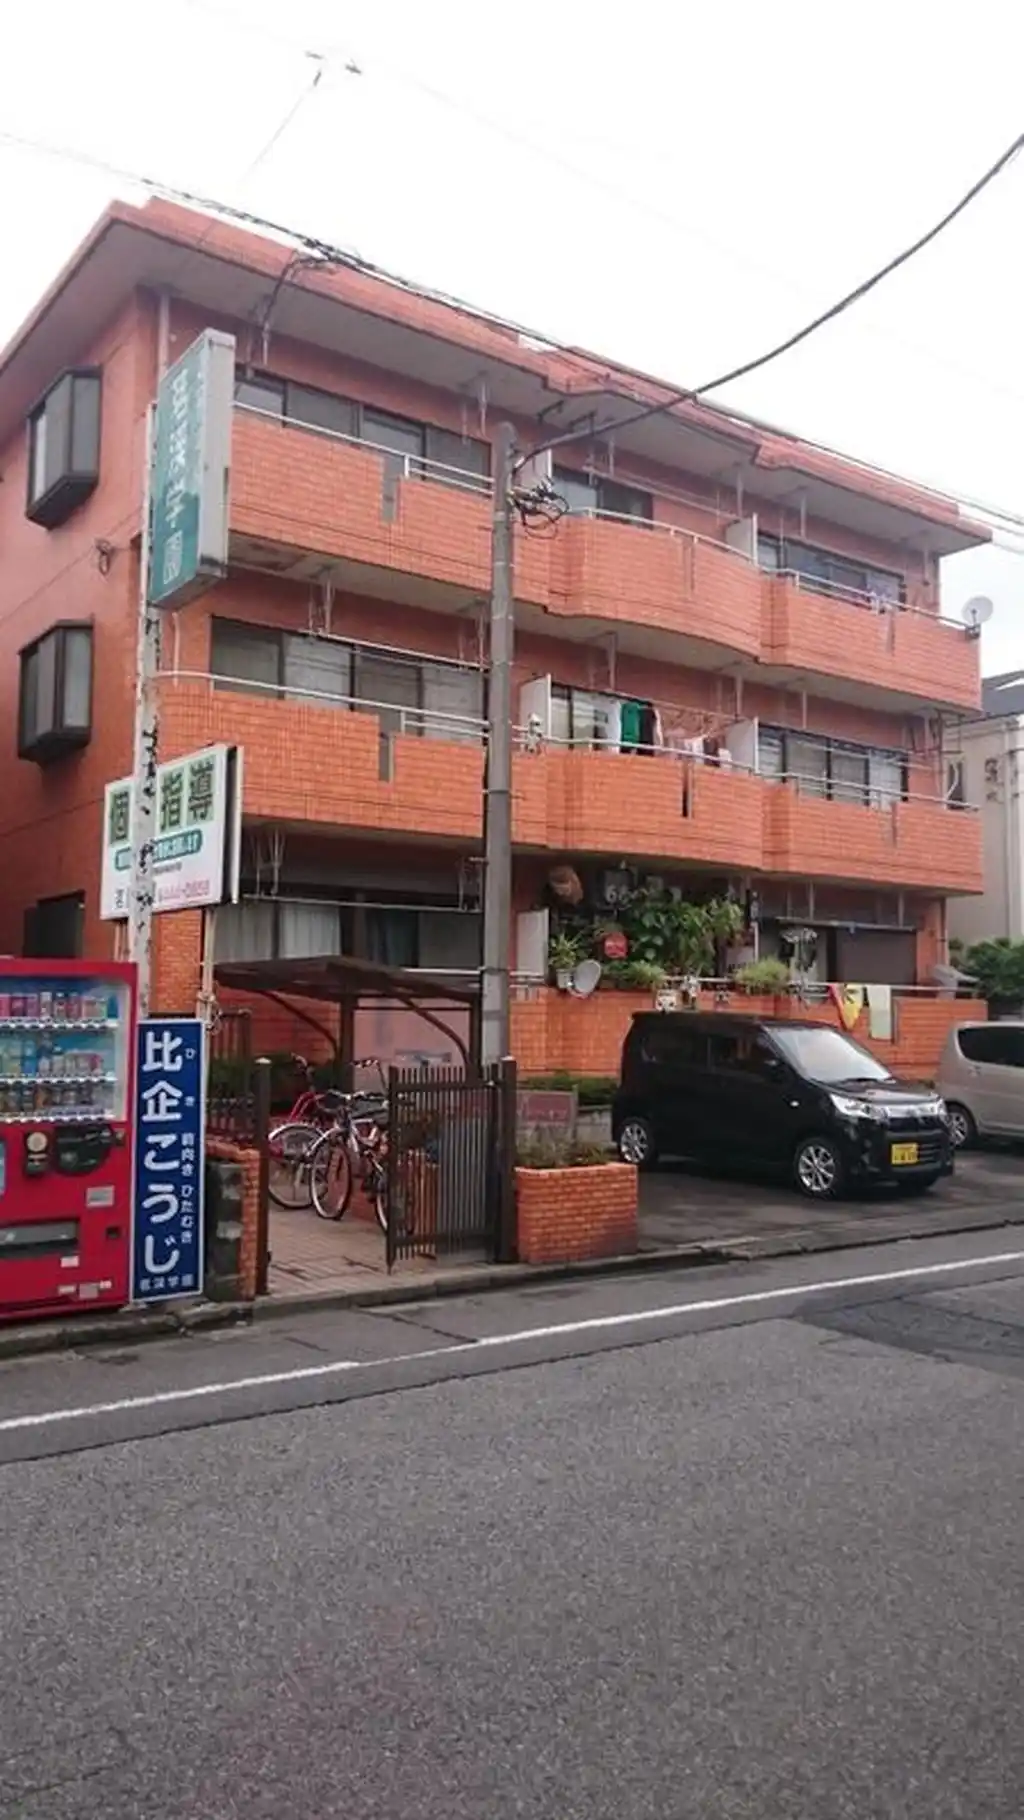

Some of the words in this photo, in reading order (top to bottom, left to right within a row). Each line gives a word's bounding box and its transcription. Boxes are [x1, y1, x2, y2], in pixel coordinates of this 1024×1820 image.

[109, 755, 215, 843] 個指導
[142, 1030, 183, 1274] 比企こうじ
